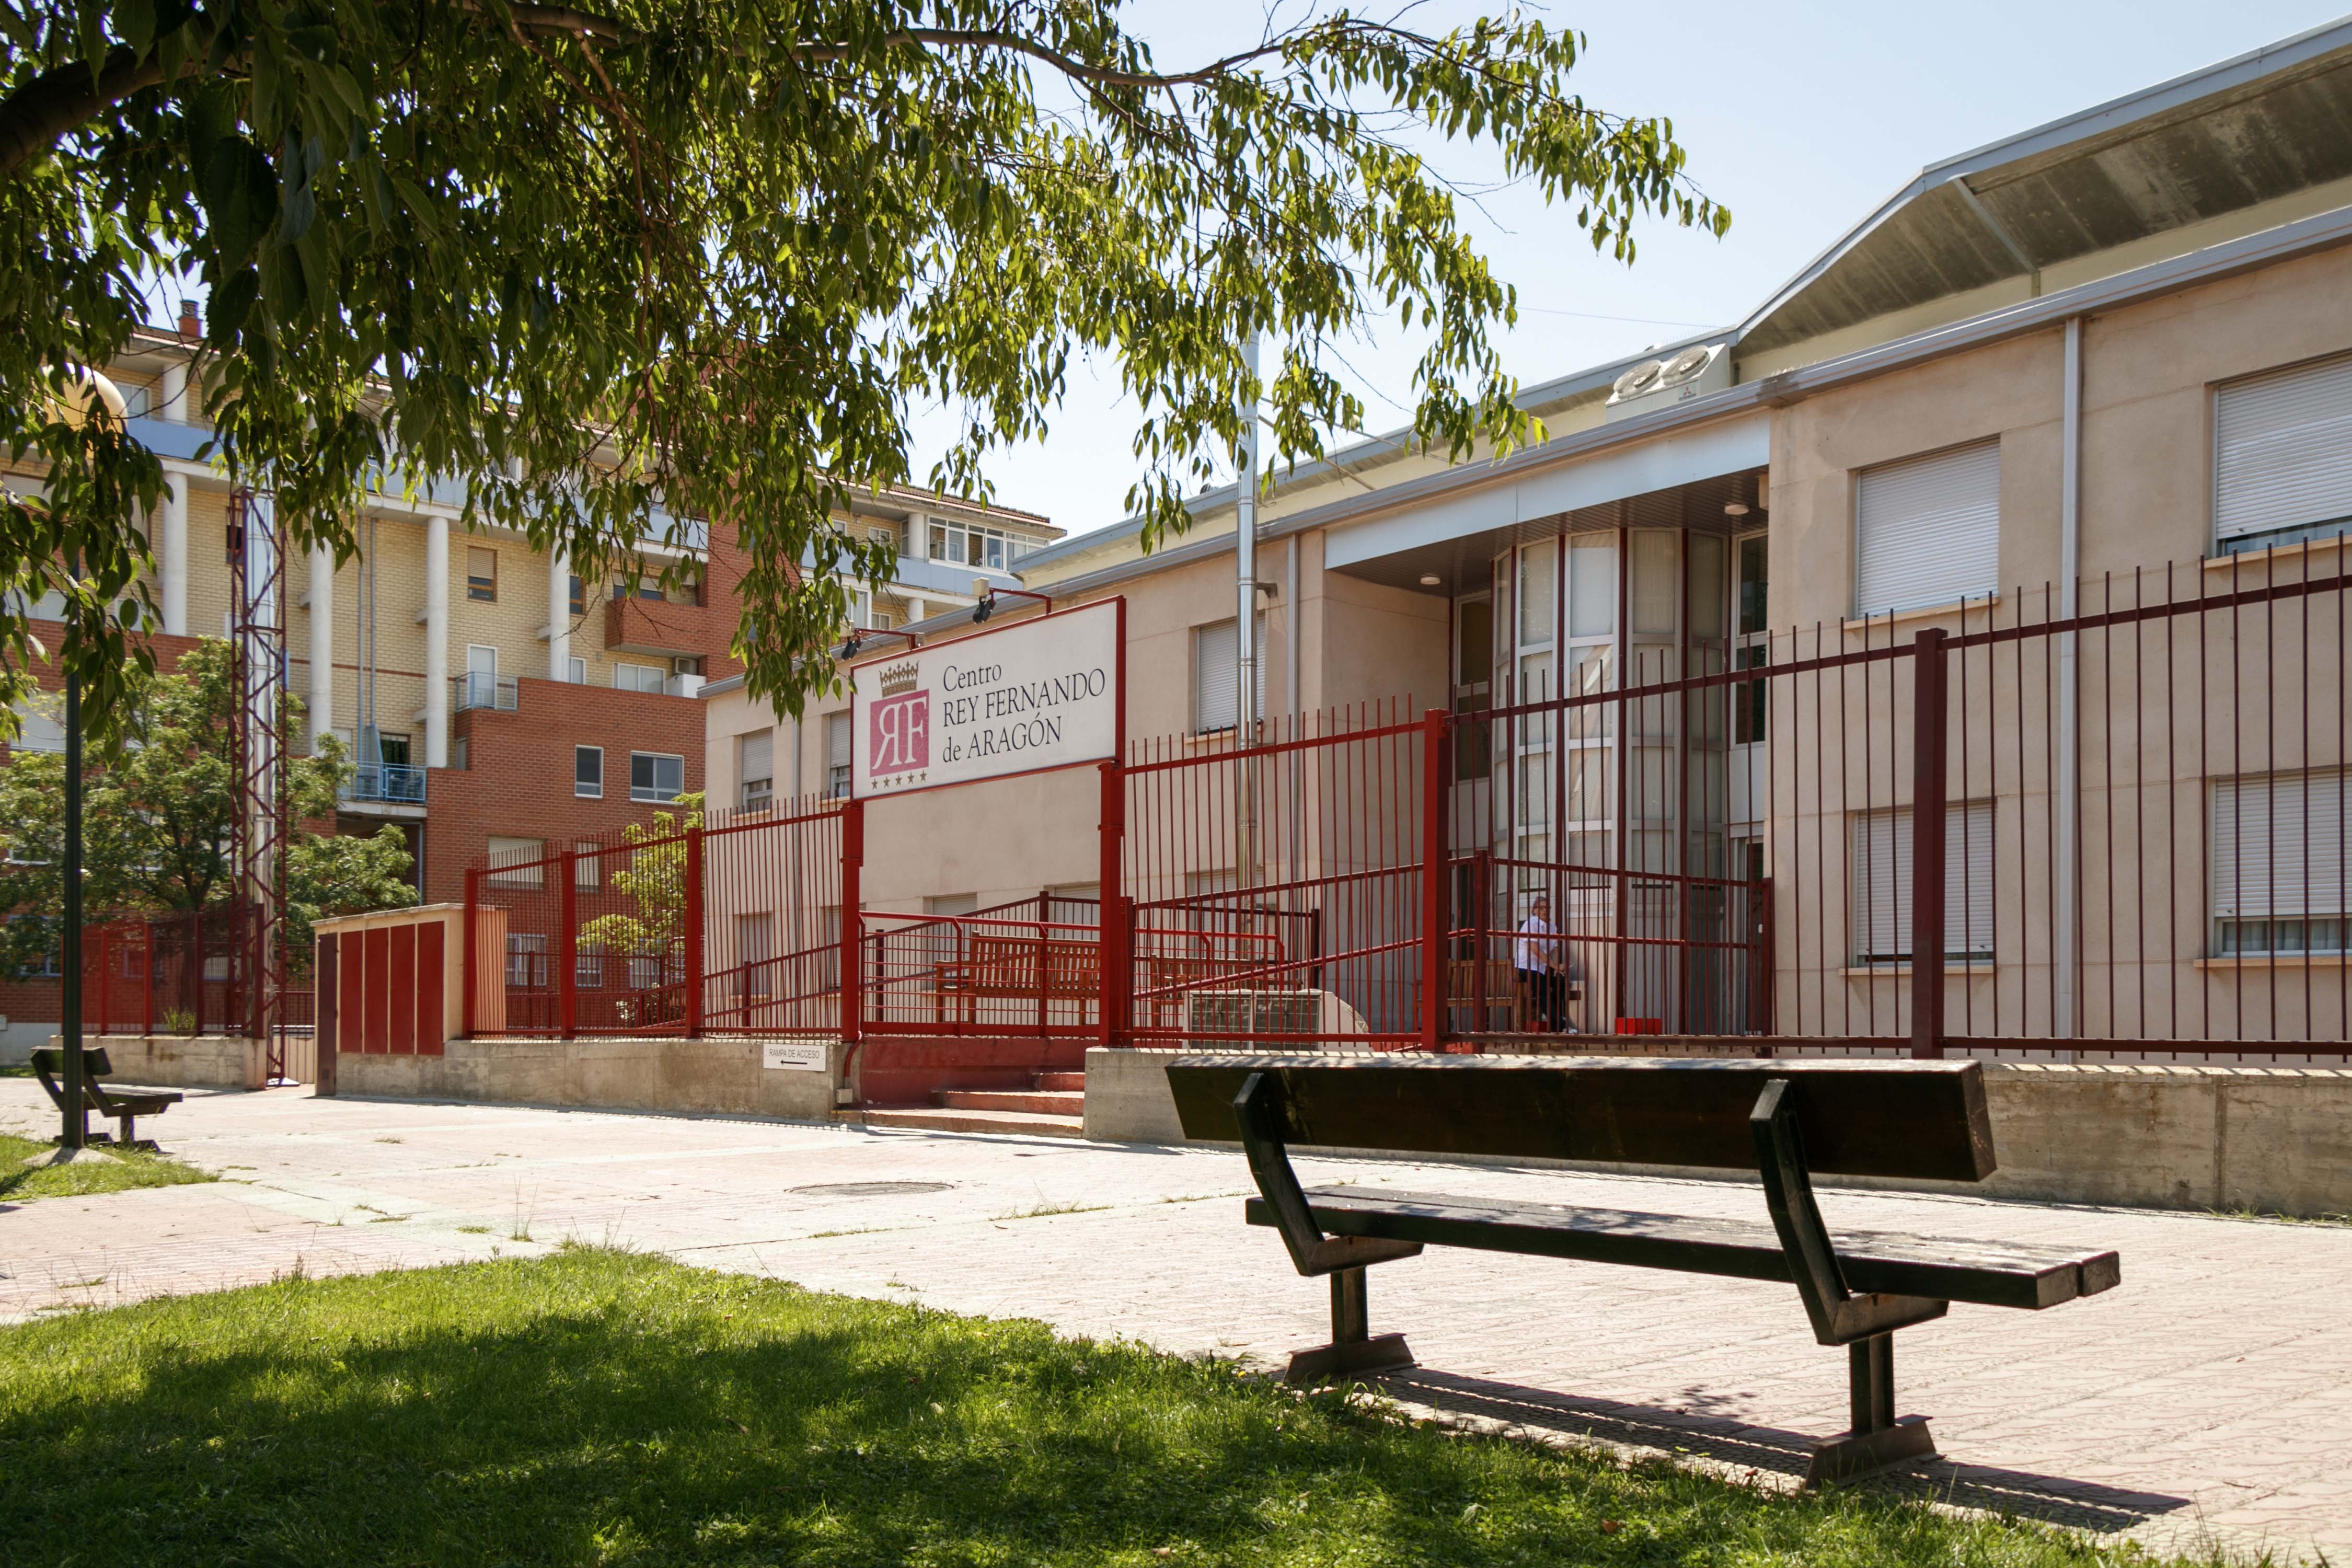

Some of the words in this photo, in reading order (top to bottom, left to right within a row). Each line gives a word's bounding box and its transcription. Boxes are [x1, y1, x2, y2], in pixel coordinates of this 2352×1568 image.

[943, 664, 1002, 691] Centro
[943, 696, 979, 727] REY
[986, 668, 1105, 719] FERNANDO
[943, 735, 962, 763] de
[967, 711, 1062, 759] ARAGÓN
[769, 1048, 787, 1057] RAMPA
[797, 1050, 820, 1058] ACCESO
